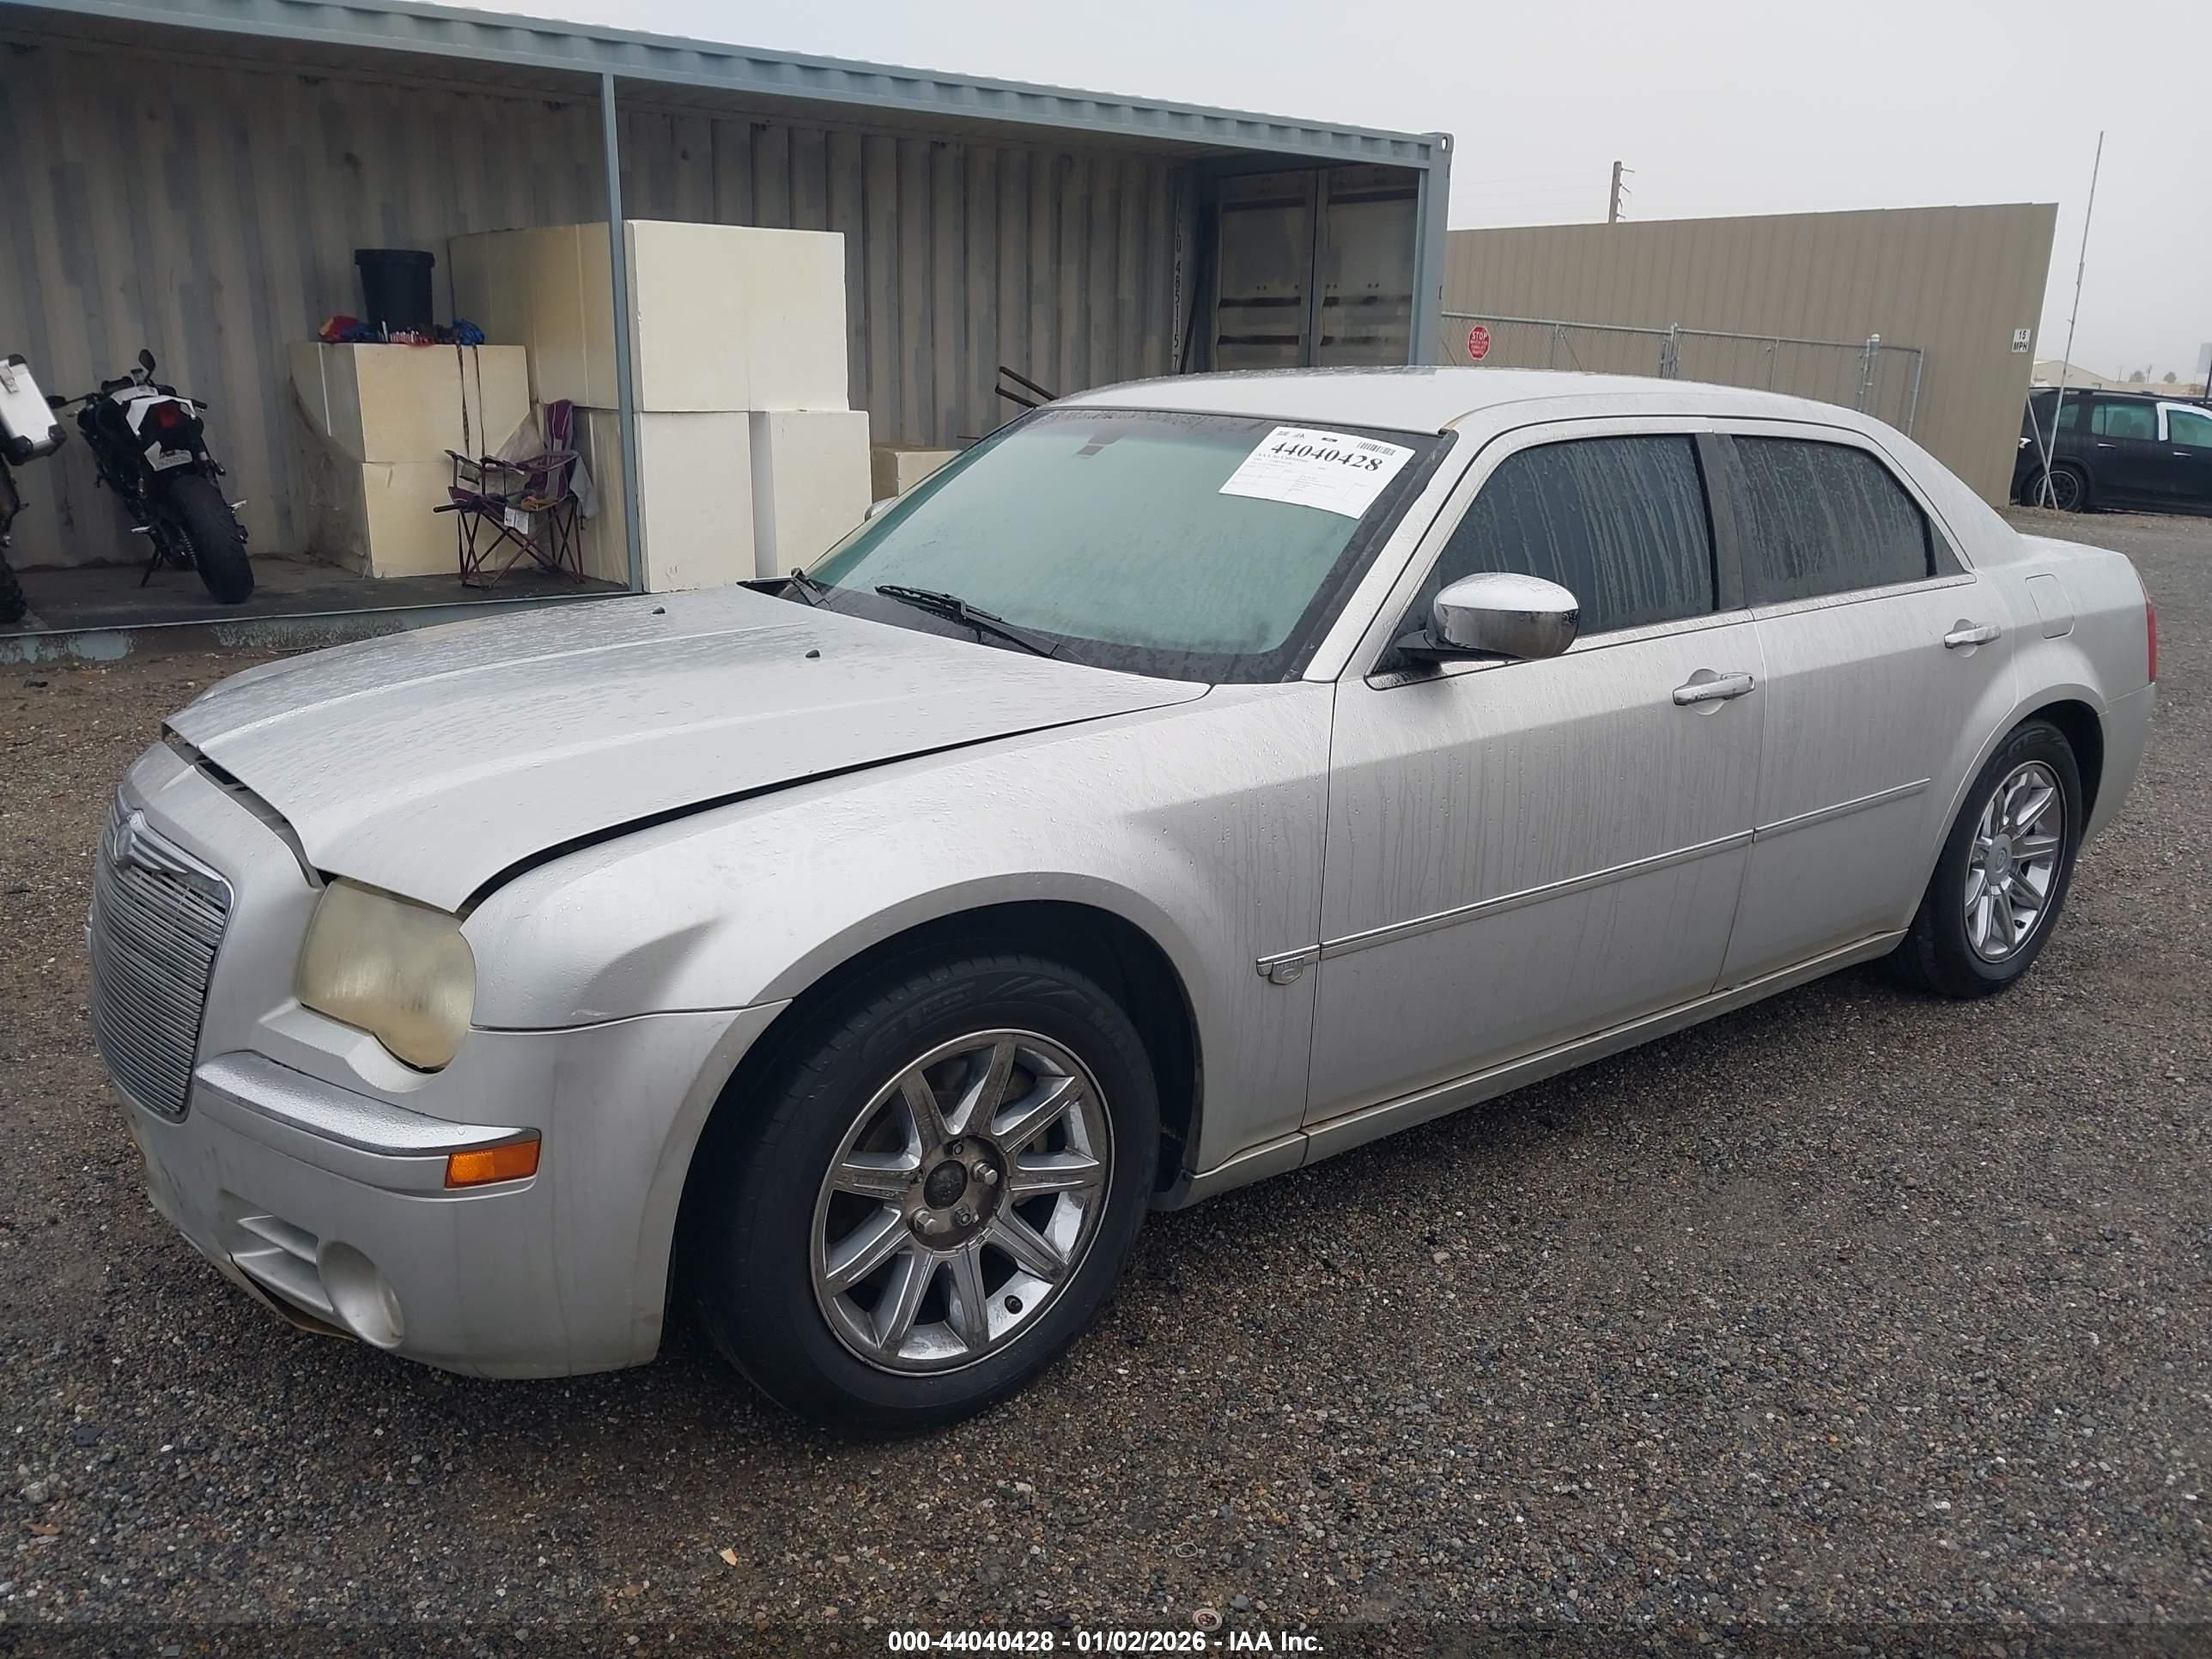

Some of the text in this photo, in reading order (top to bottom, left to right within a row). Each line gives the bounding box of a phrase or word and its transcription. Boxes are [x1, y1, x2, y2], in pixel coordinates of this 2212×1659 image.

[1472, 331, 1487, 341] STOP
[2019, 331, 2027, 340] 15
[2014, 341, 2027, 350] MPH
[1270, 441, 1384, 472] 44040428
